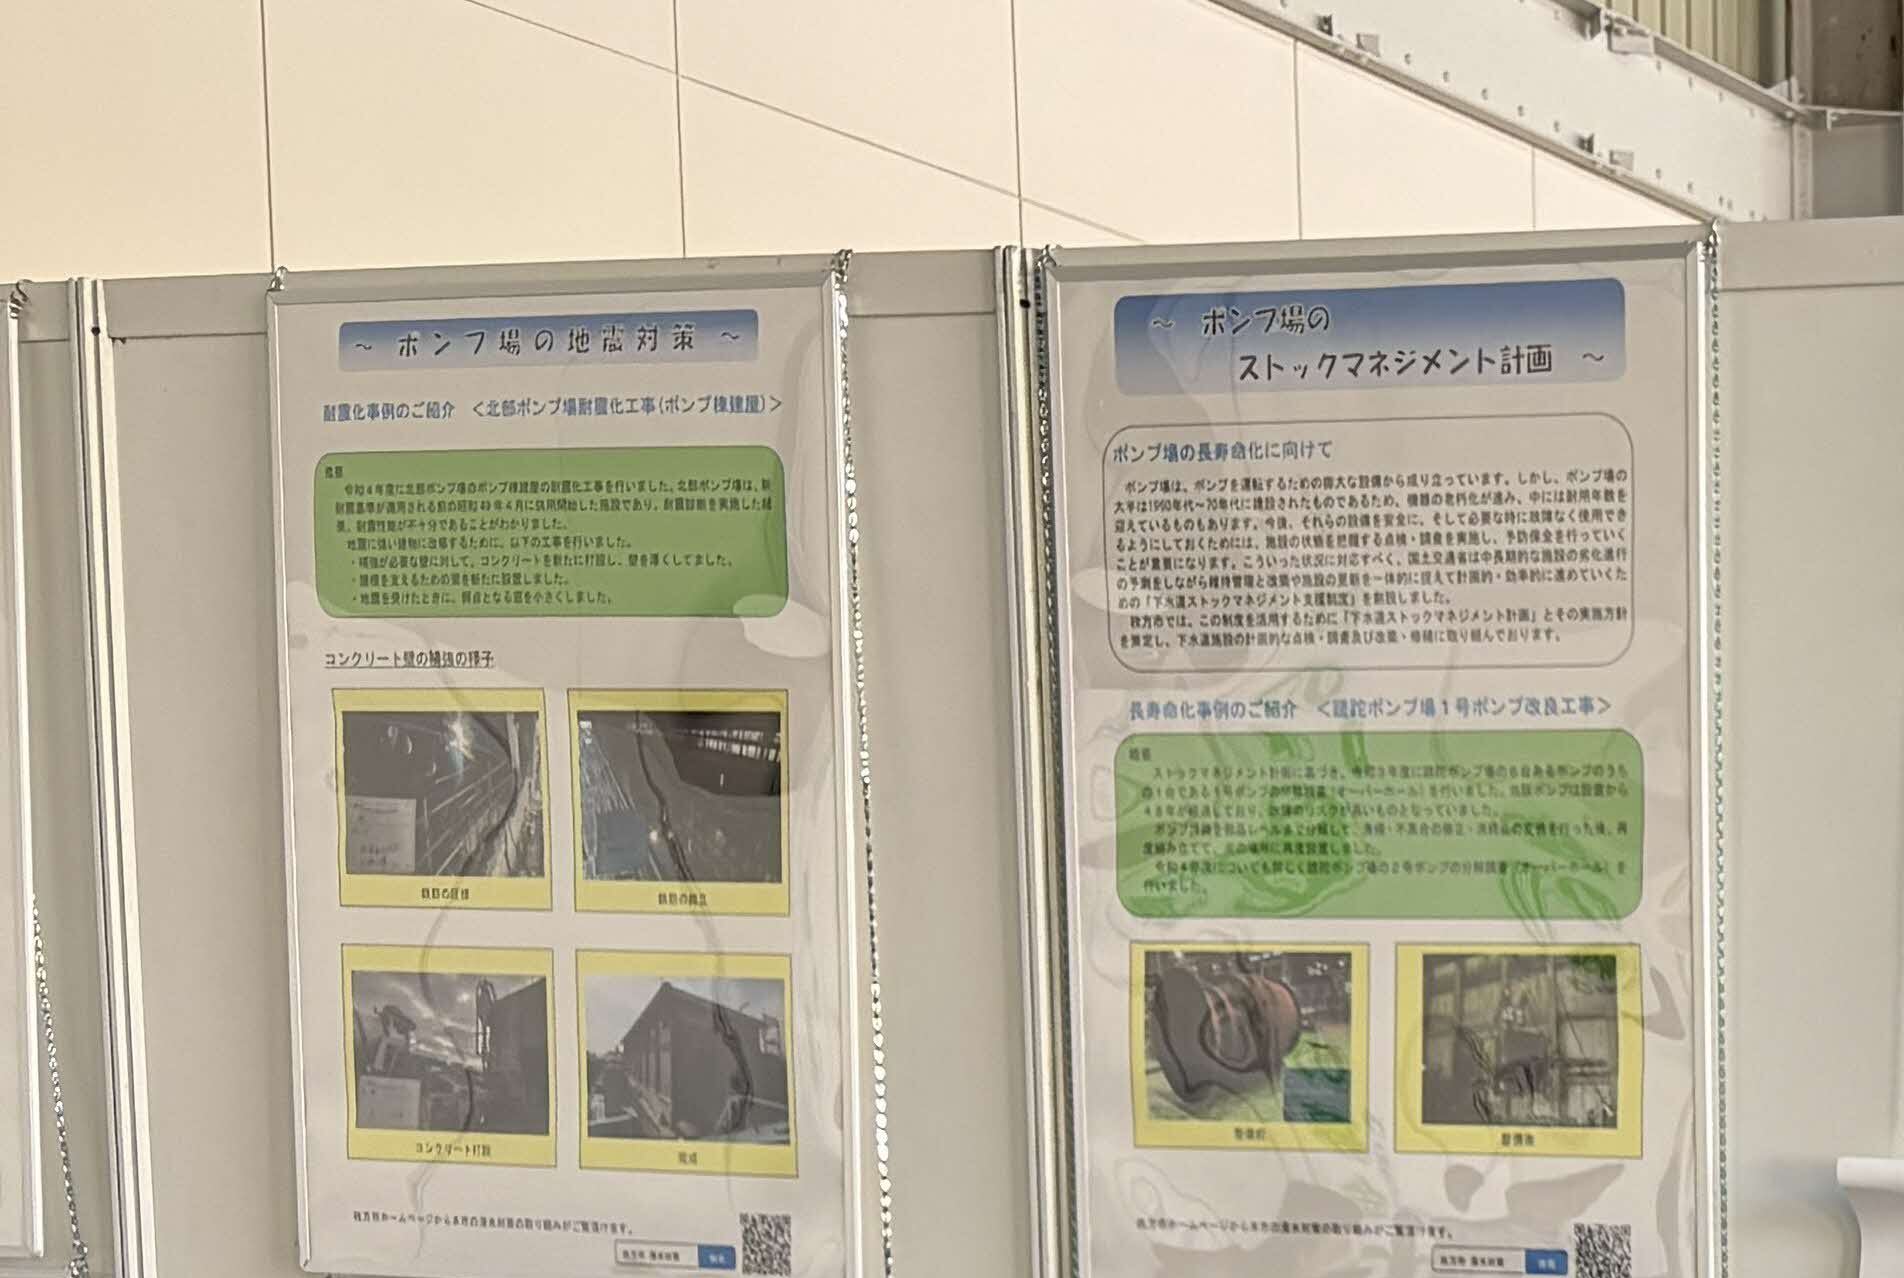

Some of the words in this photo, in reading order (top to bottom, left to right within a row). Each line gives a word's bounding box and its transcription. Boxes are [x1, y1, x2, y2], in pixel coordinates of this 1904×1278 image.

[1239, 344, 1553, 382] ストックマネジメント計画
[1113, 440, 1333, 463] ポンプ場の長寿命化に向けて
